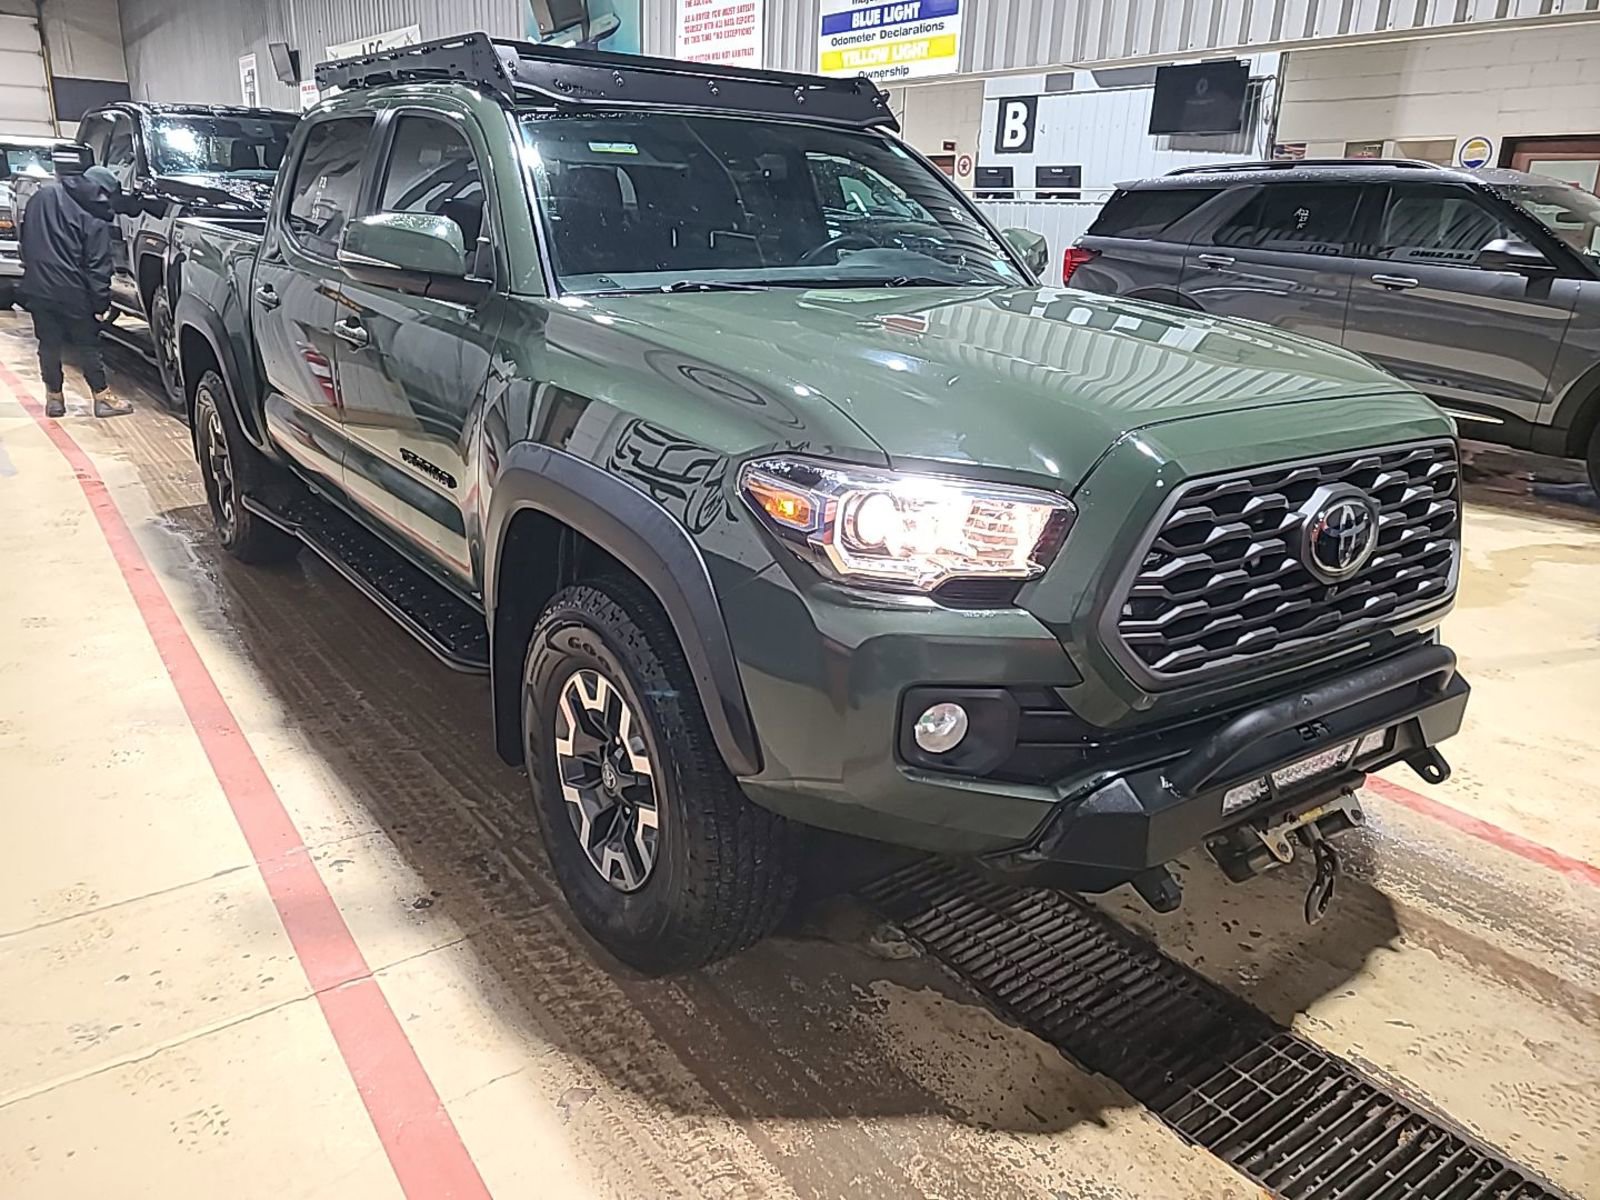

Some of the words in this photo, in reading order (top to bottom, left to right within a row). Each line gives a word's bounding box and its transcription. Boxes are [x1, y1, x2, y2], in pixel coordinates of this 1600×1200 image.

[722, 7, 736, 16] MUST
[852, 8, 881, 28] BLUE
[882, 2, 921, 24] LIGHT
[831, 31, 876, 47] Odometer
[879, 21, 945, 40] Declarations
[843, 48, 889, 67] YELLOW
[892, 42, 929, 60] LIGHT
[858, 66, 910, 78] Ownership
[1003, 102, 1028, 148] B
